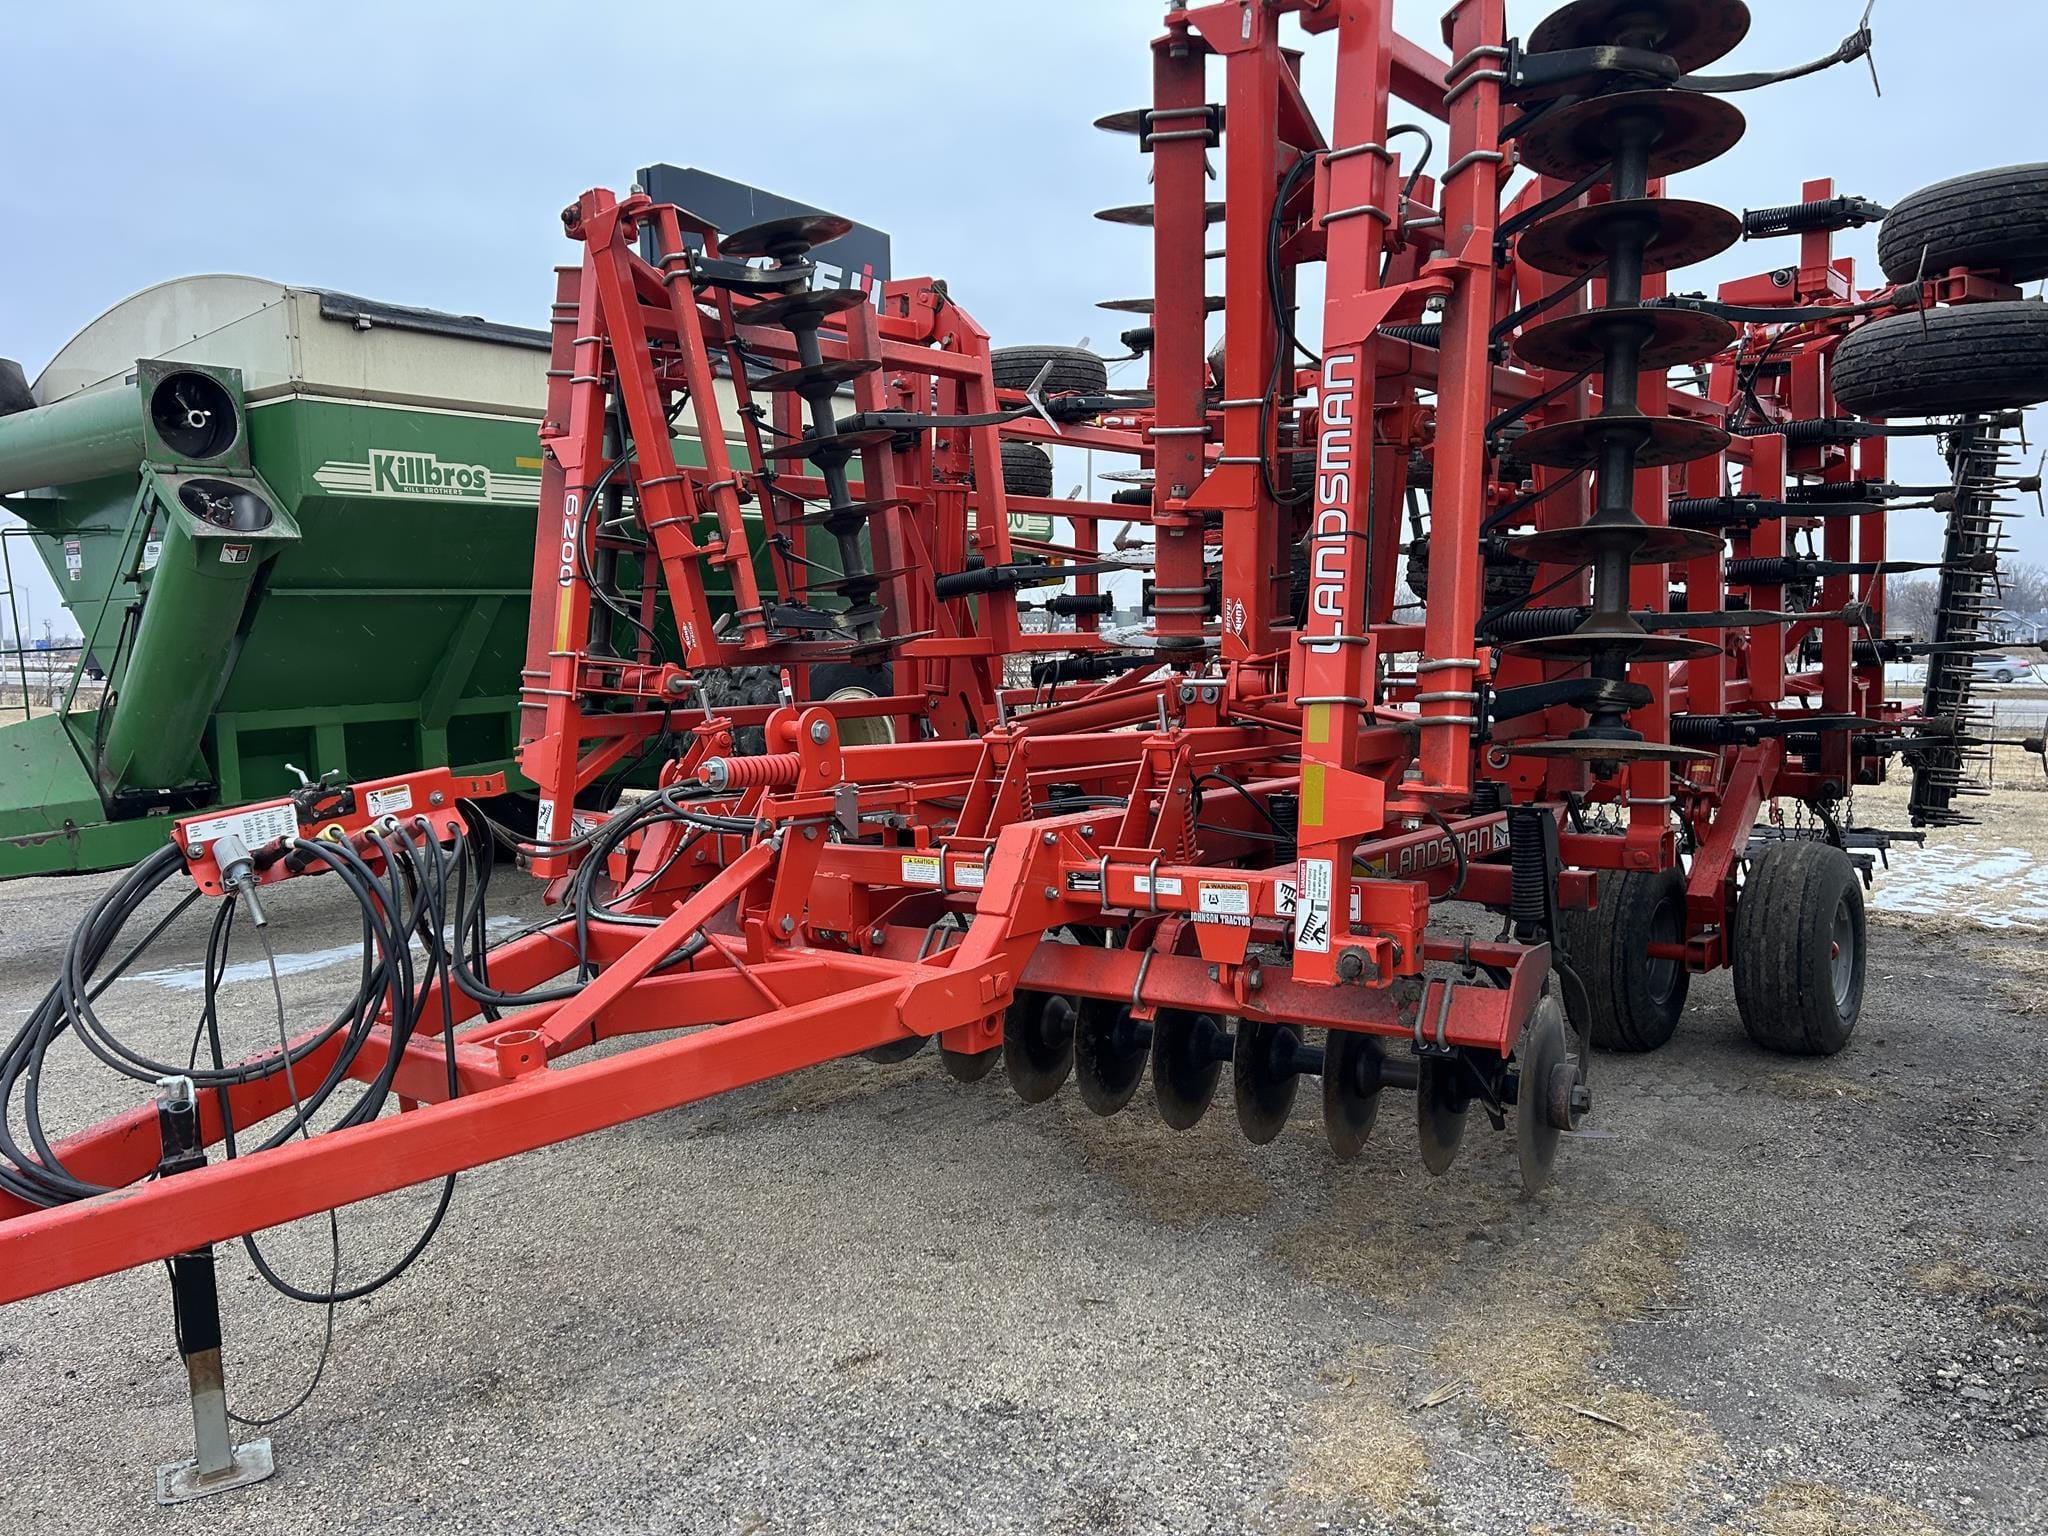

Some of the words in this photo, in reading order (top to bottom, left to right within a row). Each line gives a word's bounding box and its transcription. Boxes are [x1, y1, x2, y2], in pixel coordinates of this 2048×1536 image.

[373, 454, 487, 491] Killbros
[423, 487, 463, 496] BROTHERS
[1311, 354, 1355, 654] LANDSMAN
[559, 494, 578, 587] 6200
[1384, 825, 1491, 878] LANDSMAN
[1190, 911, 1219, 924] JOHNSON
[1220, 914, 1251, 927] TRACTOR
